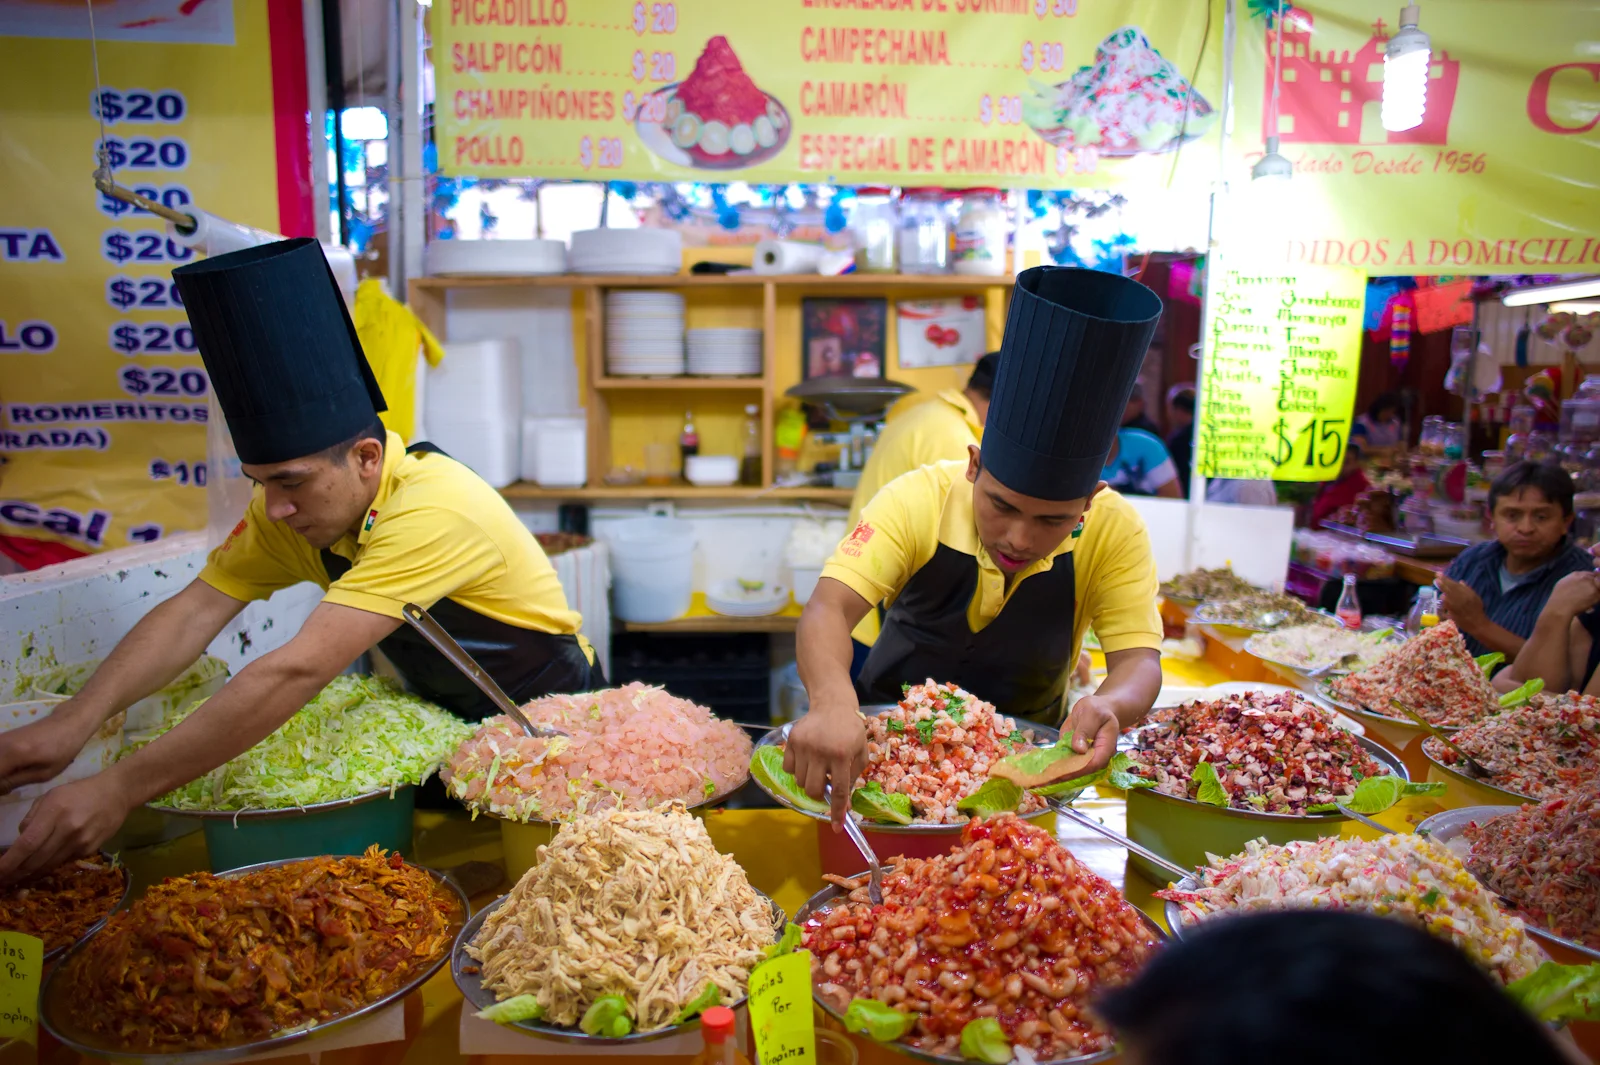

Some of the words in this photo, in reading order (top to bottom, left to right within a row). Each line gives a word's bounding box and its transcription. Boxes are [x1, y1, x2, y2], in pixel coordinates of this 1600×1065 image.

[452, 0, 567, 26] PICADILLO
[453, 36, 562, 74] SALPICÓN
[801, 26, 951, 66] CAMPECHANA
[94, 91, 184, 122] $20
[454, 83, 616, 121] CHAMPIÑONES
[800, 74, 909, 117] CAMARÓN
[97, 139, 187, 170] $20
[455, 136, 525, 166] POLLO
[799, 134, 901, 171] ESPECIAL
[908, 137, 935, 172] DE
[942, 133, 1046, 174] CAMARÓN
[1352, 151, 1424, 175] Desde
[1433, 150, 1487, 175] 1956
[1395, 239, 1418, 266] A
[1426, 238, 1600, 266] DOMICILI
[122, 367, 208, 396] $20
[11, 404, 208, 423] ROMERITOS
[0, 428, 108, 450] RADA)
[5, 962, 29, 980] Por
[771, 996, 792, 1014] Por
